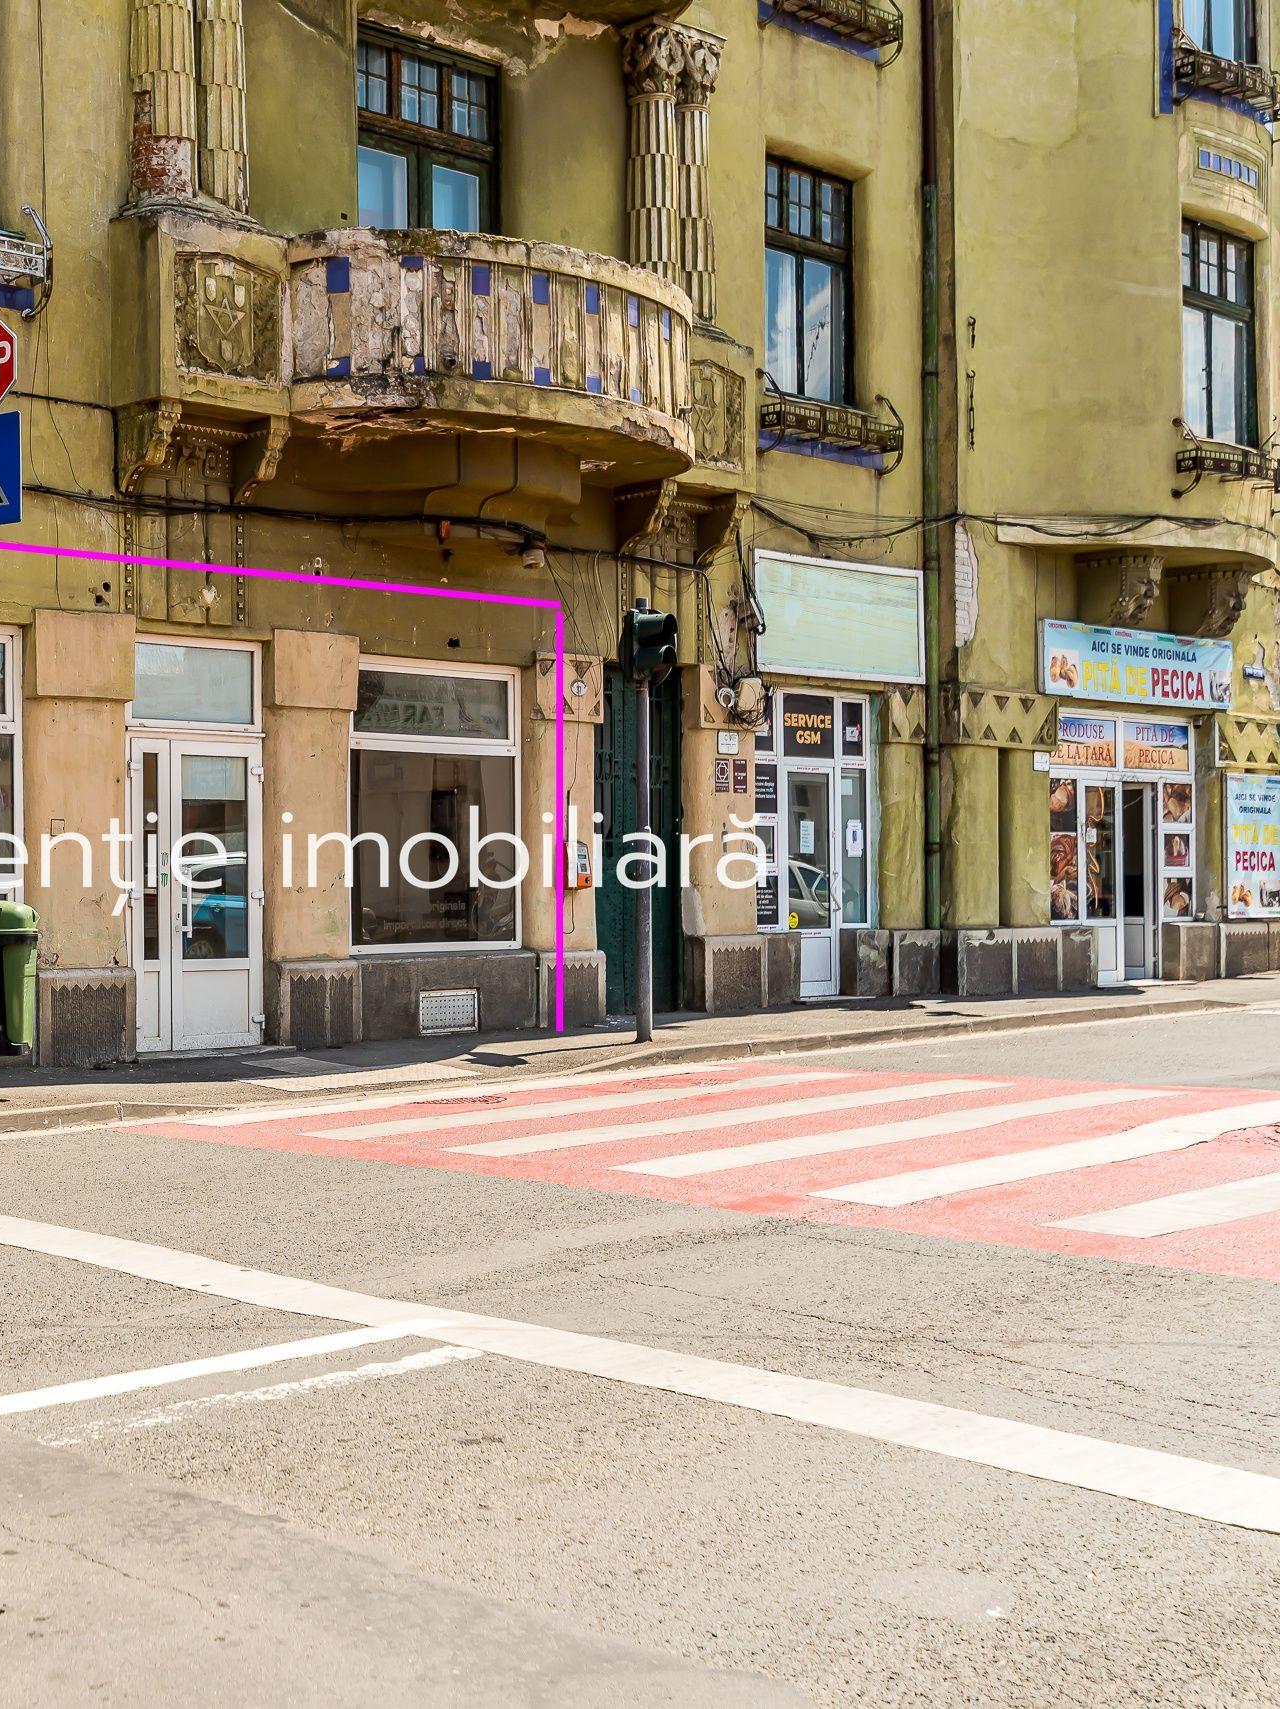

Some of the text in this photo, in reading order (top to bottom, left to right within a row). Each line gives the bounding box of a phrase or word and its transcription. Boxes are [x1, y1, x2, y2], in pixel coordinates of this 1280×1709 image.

[1091, 640, 1197, 663] AICI SE VINDE ORIGINALA
[1125, 665, 1148, 697] DE
[1151, 667, 1205, 701] PECICA
[784, 712, 832, 729] SERVICE
[795, 730, 821, 744] GSM
[1160, 727, 1175, 743] DE
[1067, 744, 1081, 760] LA
[1139, 749, 1175, 765] PECICA
[1234, 793, 1247, 801] AICI
[1257, 794, 1276, 803] VINDE
[1238, 805, 1272, 815] ORIGINALA
[1262, 824, 1279, 846] DE
[1235, 850, 1276, 872] PECICA
